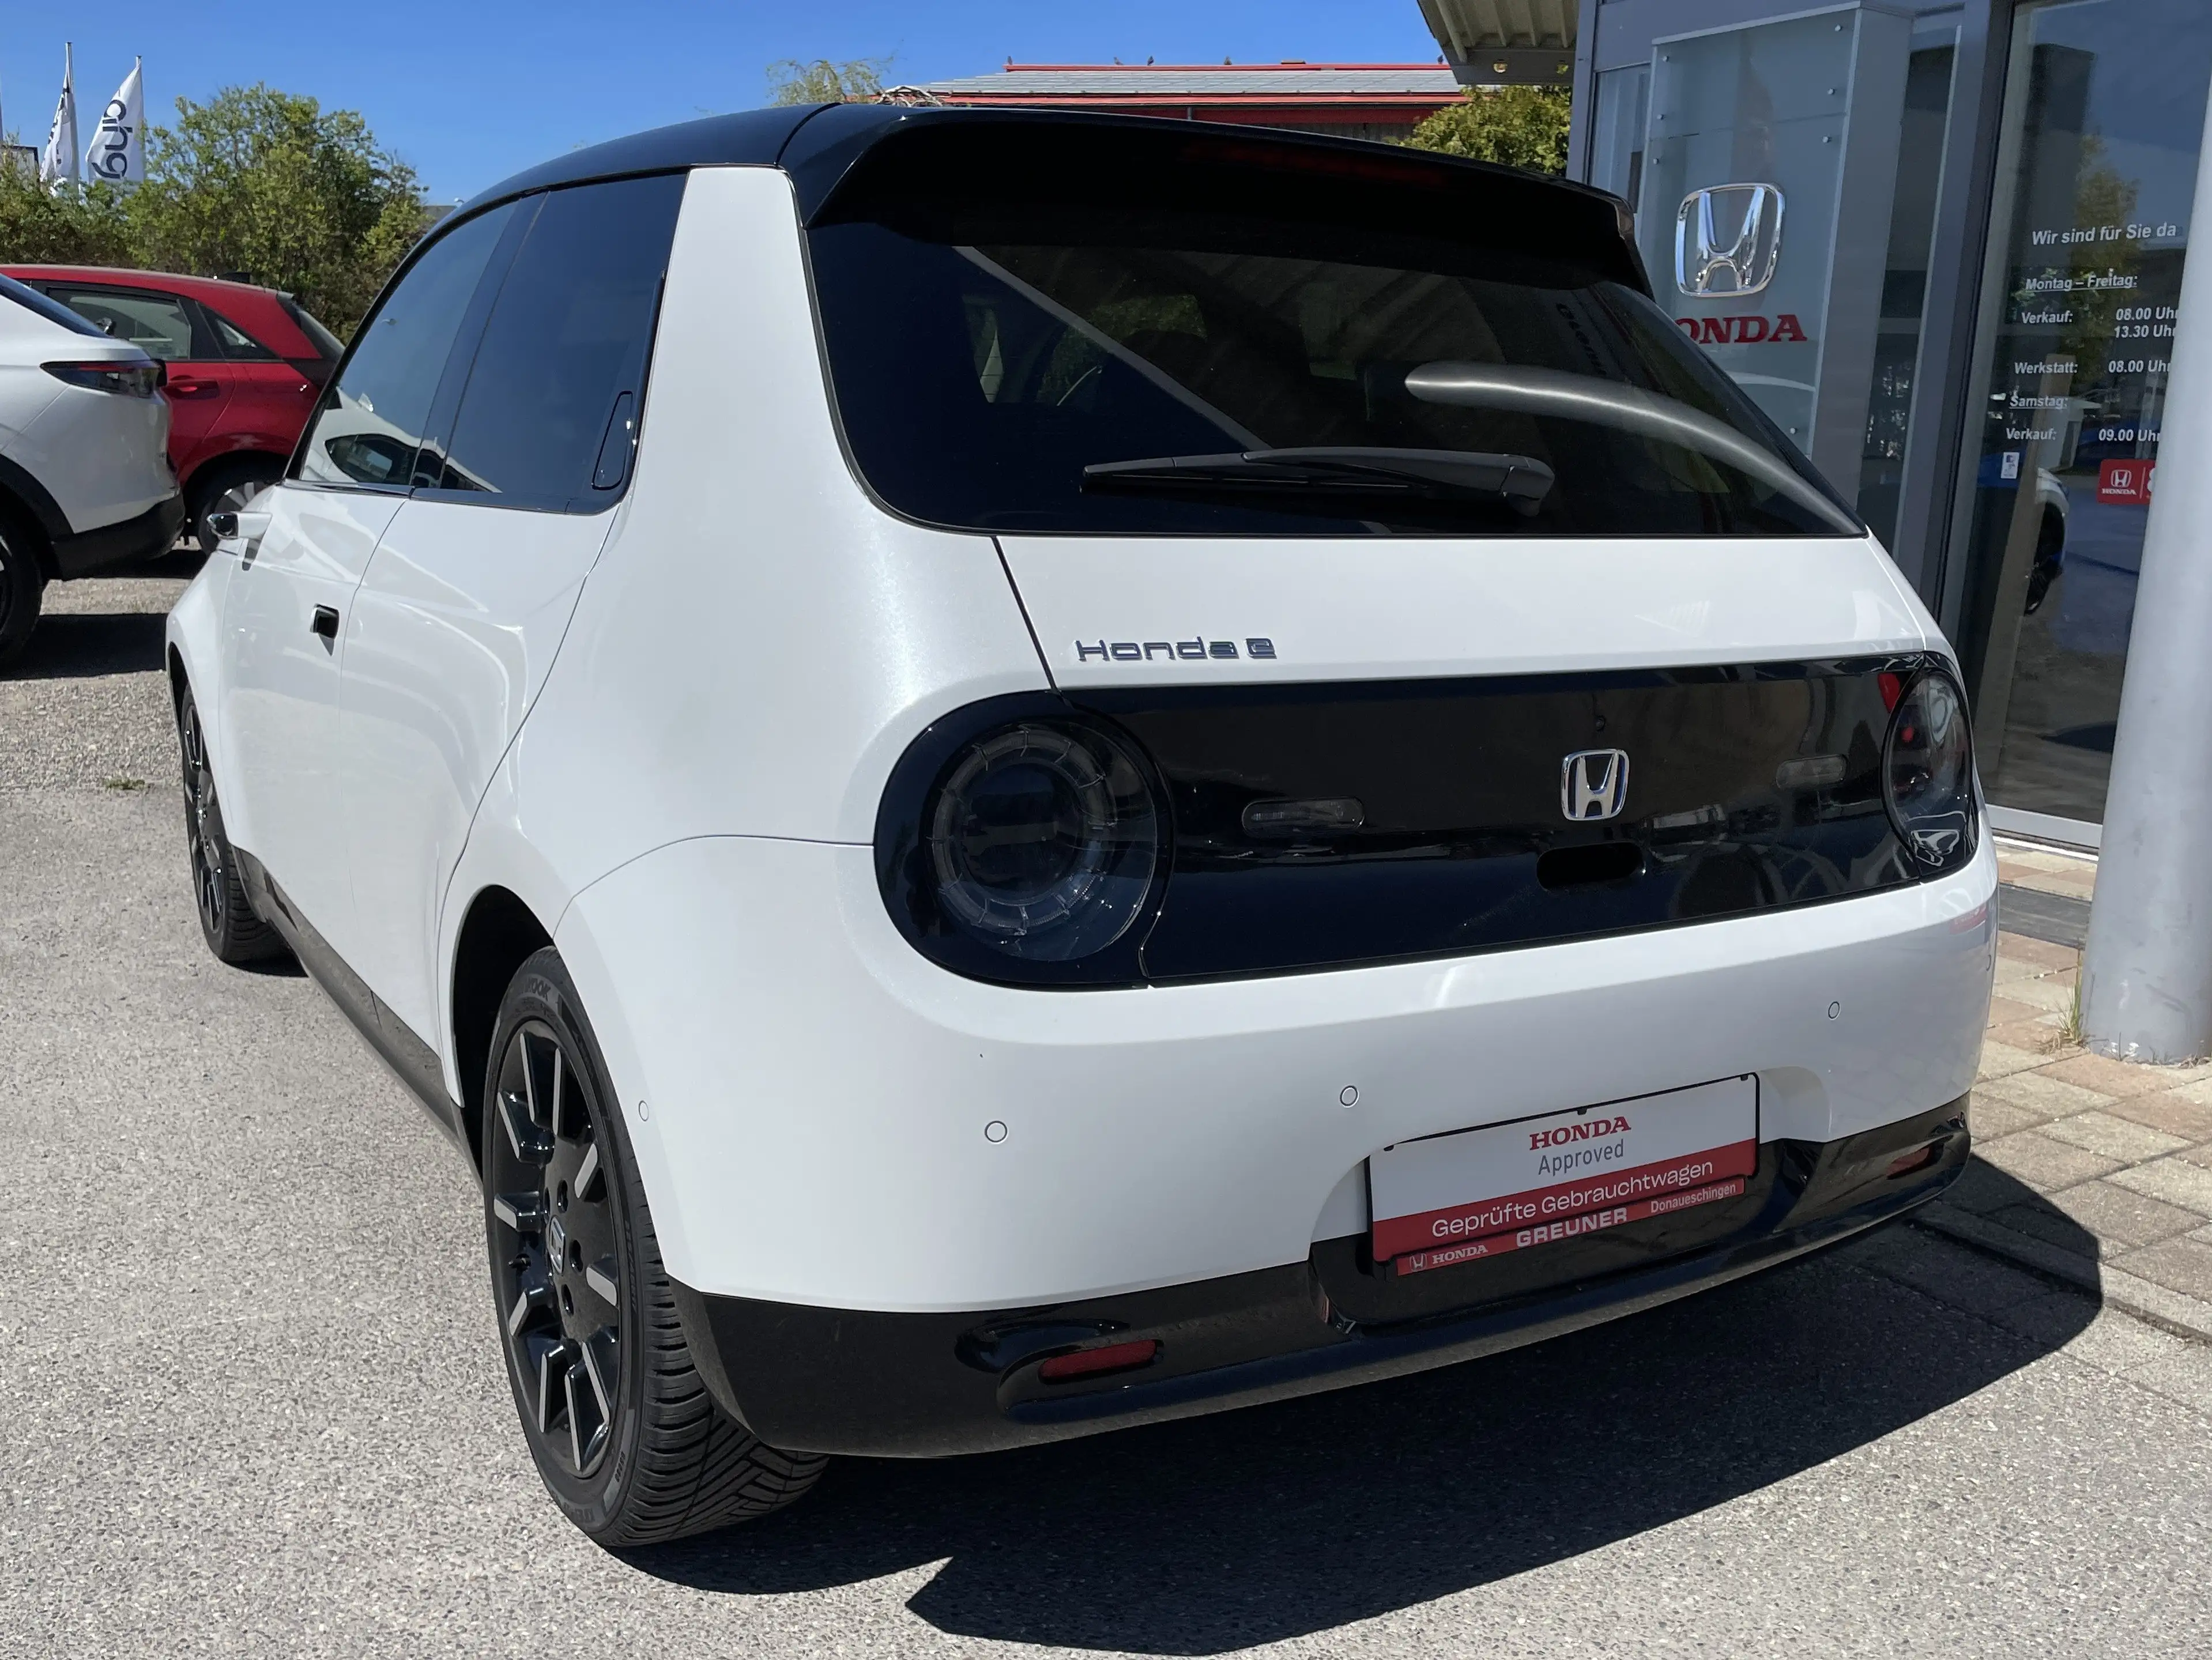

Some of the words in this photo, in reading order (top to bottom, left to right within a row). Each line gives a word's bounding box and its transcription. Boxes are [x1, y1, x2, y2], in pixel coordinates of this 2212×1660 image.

[2032, 231, 2057, 246] Wir
[2061, 226, 2096, 243] sind
[2099, 225, 2122, 241] für
[2126, 224, 2151, 240] Sie
[2156, 222, 2176, 237] da
[2026, 277, 2072, 292] Montag
[2087, 273, 2138, 289] Freitag:
[2021, 311, 2073, 325] Verkauf:
[2115, 307, 2151, 321] 08.00
[1674, 314, 1808, 344] ONDA
[2114, 325, 2149, 338] 13.30
[2014, 361, 2078, 375] Werkstatt:
[2108, 360, 2145, 373] 08.00
[2009, 395, 2068, 409] Samstag:
[2006, 428, 2056, 441] Verkauf:
[2098, 428, 2134, 442] 09.00
[1073, 636, 1239, 662] Honda
[1243, 637, 1277, 660] e
[1529, 1116, 1631, 1151] HONDA
[1538, 1139, 1625, 1177] Approved
[1431, 1201, 1536, 1238] Geprüfte
[1541, 1160, 1713, 1214] Gebrauchtwagen
[1432, 1244, 1489, 1265] HONDA
[1516, 1208, 1627, 1248] GREUNER
[1650, 1182, 1736, 1213] Donaueschingen
